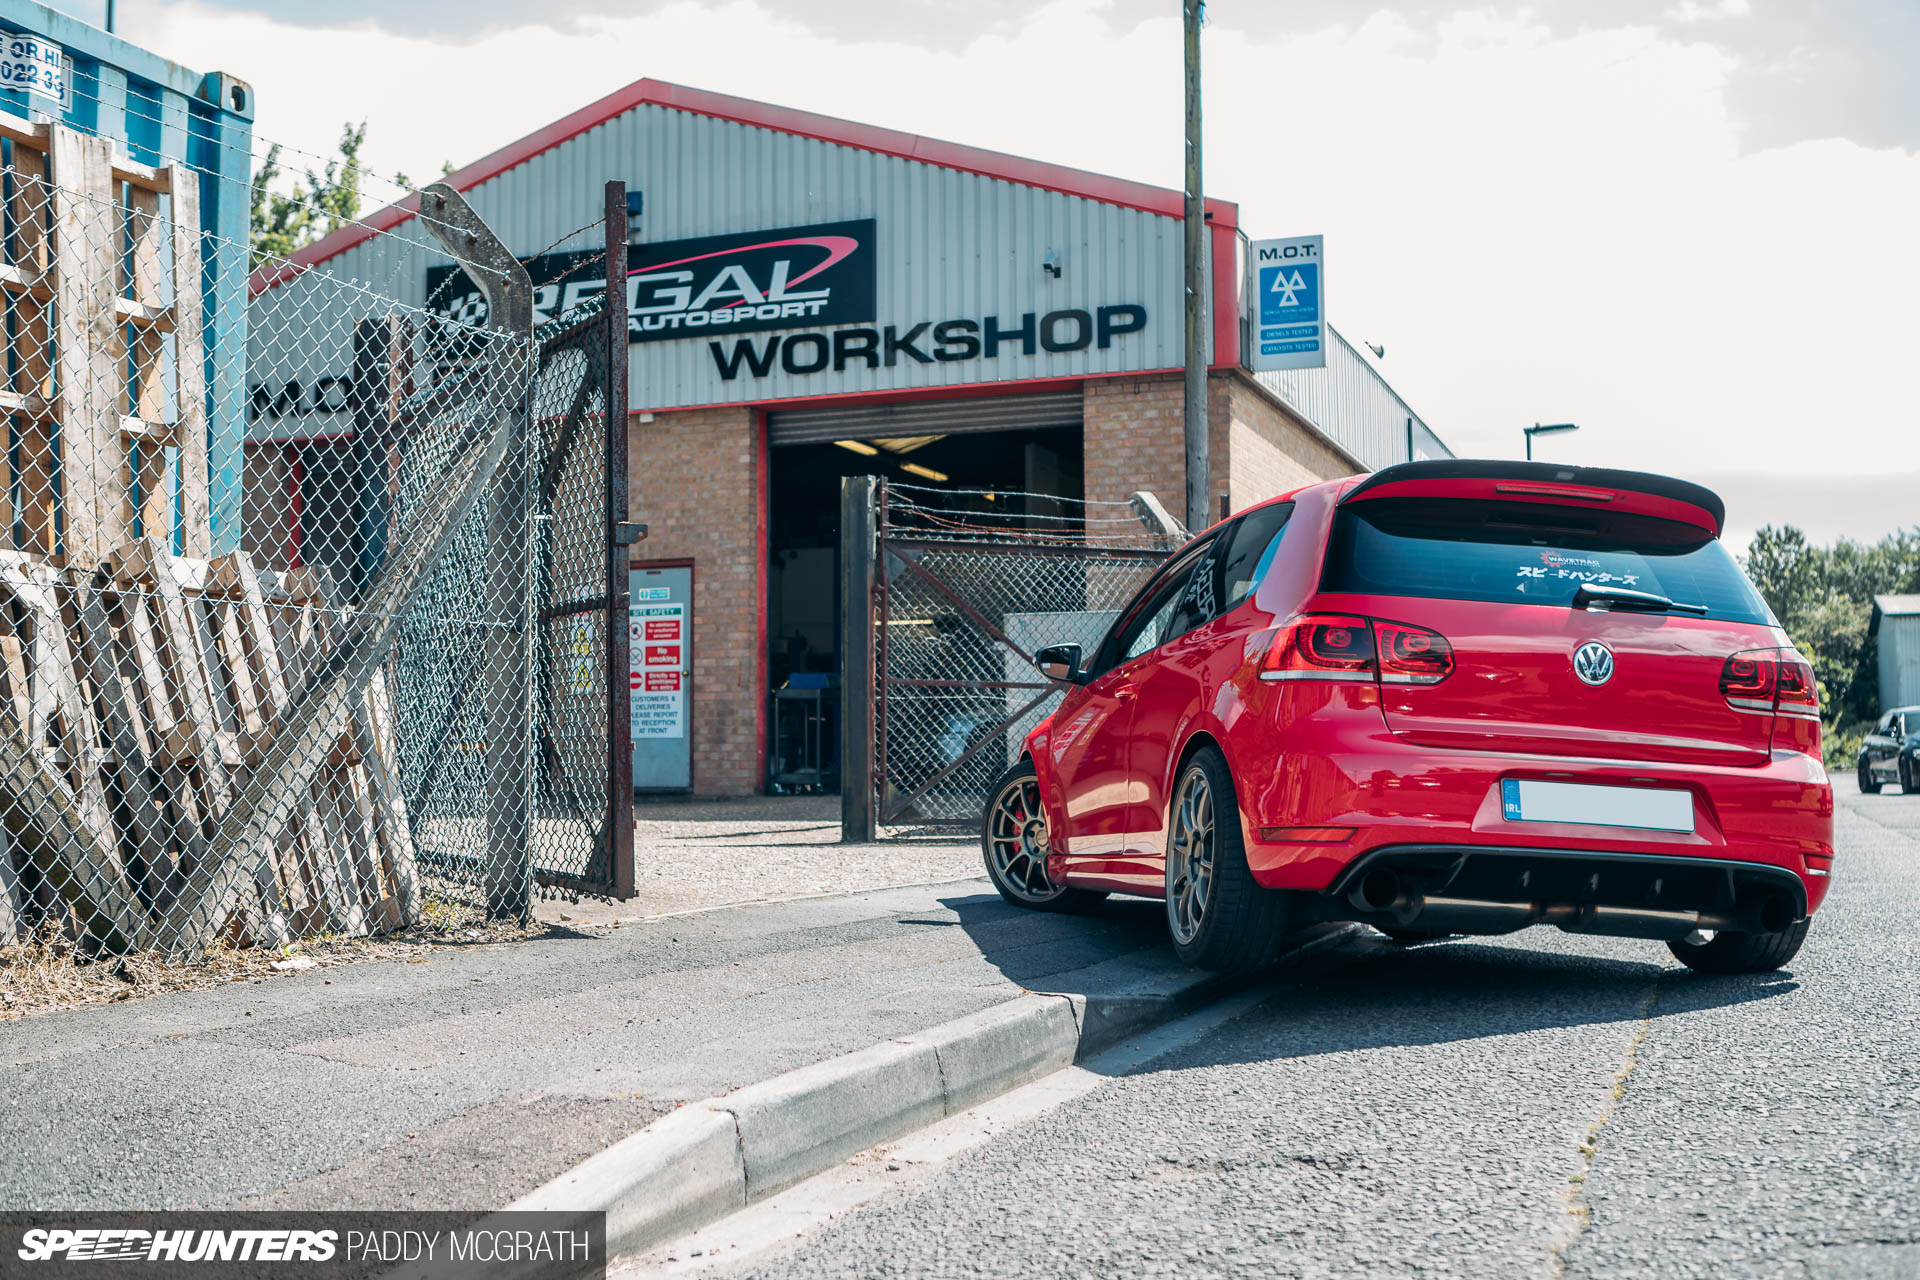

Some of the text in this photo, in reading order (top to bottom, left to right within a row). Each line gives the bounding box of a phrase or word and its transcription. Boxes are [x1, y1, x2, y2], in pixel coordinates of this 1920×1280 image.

[10, 41, 38, 59] OR
[1259, 244, 1318, 261] M.O.T.
[628, 299, 829, 332] AUTOSPORT
[709, 304, 1148, 381] WORKSHOP
[649, 608, 675, 616] SAFETY
[657, 647, 668, 655] No
[648, 656, 677, 664] smoking
[1505, 803, 1521, 813] IRL
